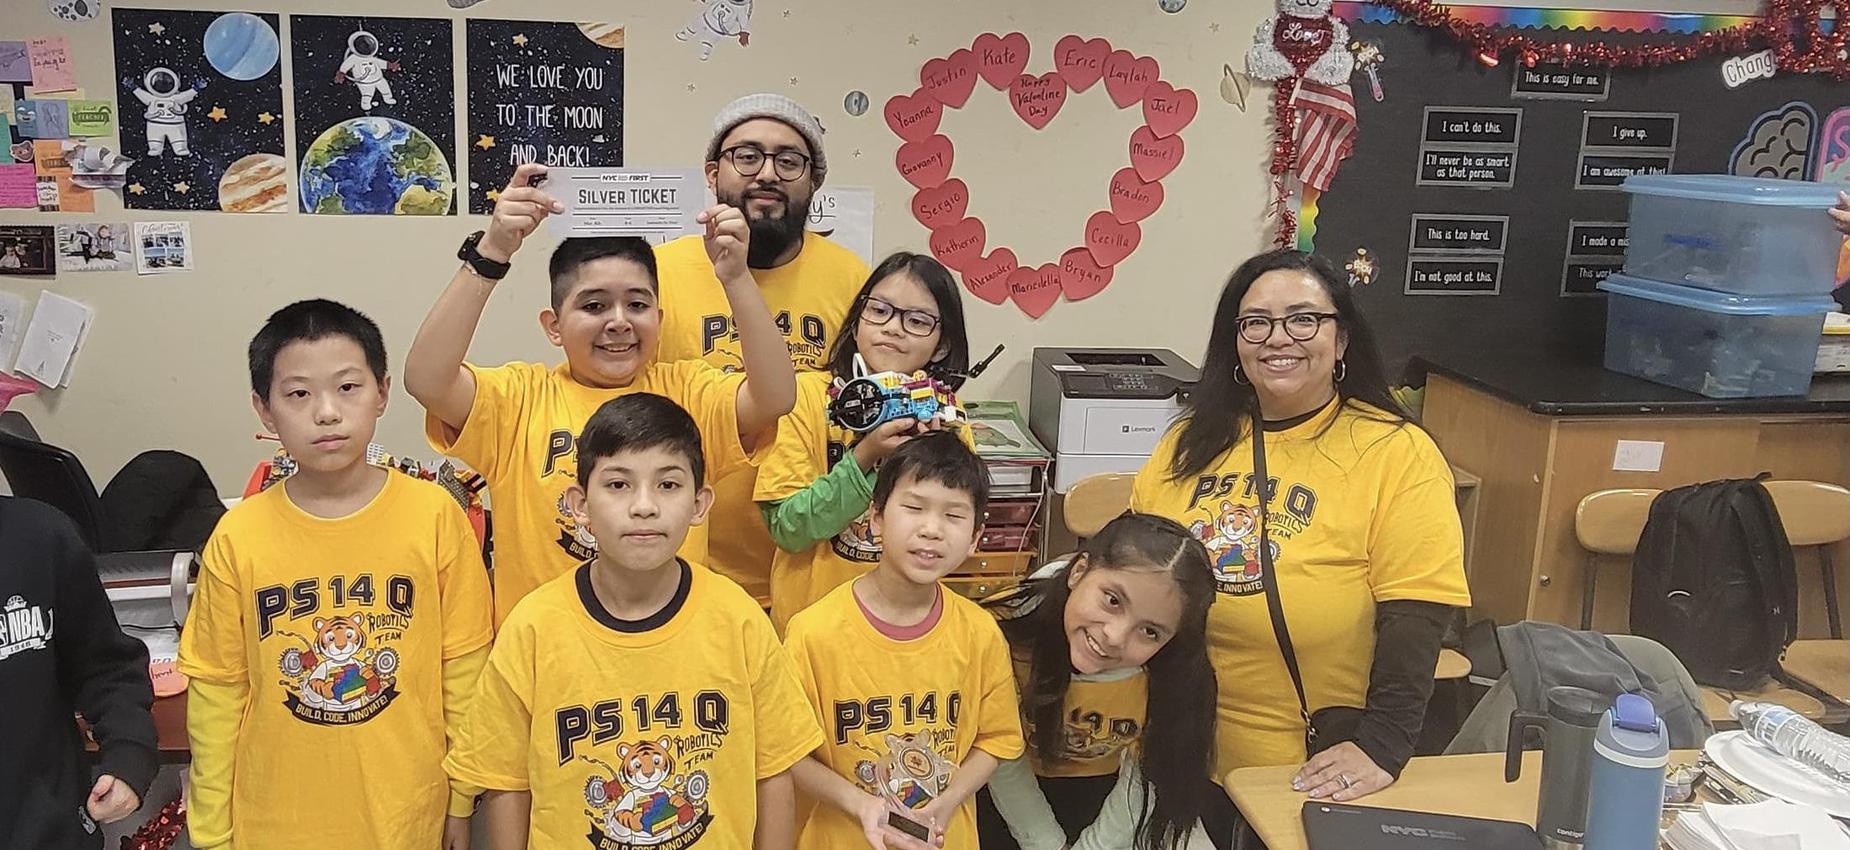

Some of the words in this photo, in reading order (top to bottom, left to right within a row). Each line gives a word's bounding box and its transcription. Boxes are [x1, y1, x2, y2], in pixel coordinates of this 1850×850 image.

[983, 46, 1016, 66] Kate
[1064, 49, 1096, 69] Eric
[496, 64, 520, 88] WE
[530, 65, 565, 89] LOVE
[575, 67, 603, 90] YOU
[926, 67, 967, 89] Justin
[1109, 64, 1149, 84] Laylah
[1726, 53, 1773, 83] Chang
[1525, 71, 1541, 83] This
[1543, 74, 1550, 83] is
[1552, 75, 1569, 87] easy
[1572, 73, 1584, 84] for
[496, 104, 515, 126] TO
[525, 105, 554, 128] THE
[564, 106, 602, 129] MOON
[1029, 106, 1048, 117] Day
[1150, 98, 1181, 115] Jael
[1442, 121, 1447, 132] I
[1450, 121, 1469, 133] can't
[1472, 122, 1482, 133] do
[1485, 121, 1502, 133] this.
[1612, 126, 1618, 138] I
[1620, 128, 1635, 140] give
[1637, 129, 1648, 140] up.
[510, 144, 537, 166] AND
[547, 144, 590, 167] BACK!
[1426, 154, 1437, 165] I'll
[1439, 157, 1461, 166] never
[1463, 155, 1472, 166] be
[1475, 158, 1484, 166] as
[1486, 156, 1510, 167] smart
[1436, 169, 1446, 178] as
[1448, 167, 1467, 178] that
[1468, 170, 1495, 181] person.
[1583, 165, 1588, 176] I
[1590, 168, 1601, 176] am
[1603, 168, 1634, 176] awesome
[579, 189, 625, 204] SILVER
[630, 189, 677, 204] TICKET
[1112, 181, 1150, 203] Braden
[808, 194, 835, 224] y's
[920, 192, 961, 220] Sergio
[1428, 228, 1442, 239] This
[1445, 229, 1452, 239] is
[1455, 229, 1467, 240] too
[1470, 229, 1490, 240] hard.
[1582, 235, 1587, 246] I
[1589, 235, 1607, 246] made
[1610, 238, 1616, 246] a
[1065, 260, 1101, 283] Bryan
[1414, 270, 1426, 282] I'm
[1428, 271, 1442, 282] not
[1444, 272, 1462, 284] good
[1464, 272, 1474, 282] at
[1477, 271, 1493, 282] this.
[1579, 267, 1593, 278] This
[773, 310, 793, 336] 4
[800, 313, 826, 349] Q
[1131, 425, 1156, 433] Lexmark
[1184, 472, 1241, 513] PS
[1284, 482, 1318, 527] Q
[255, 577, 320, 641] PS
[328, 573, 375, 608] 14
[387, 574, 415, 619] Q
[8, 606, 45, 643] NBA
[366, 613, 410, 634] ROBOTICS
[375, 632, 402, 645] TEAM
[834, 695, 892, 745] PS
[899, 691, 937, 726] 14
[555, 698, 624, 767] PS
[632, 691, 683, 732] 14
[694, 690, 729, 735] Q
[675, 733, 722, 759] ROBOTICS
[931, 728, 955, 750] ROBOT
[684, 751, 713, 770] TEAM
[1381, 824, 1428, 837] NYC
